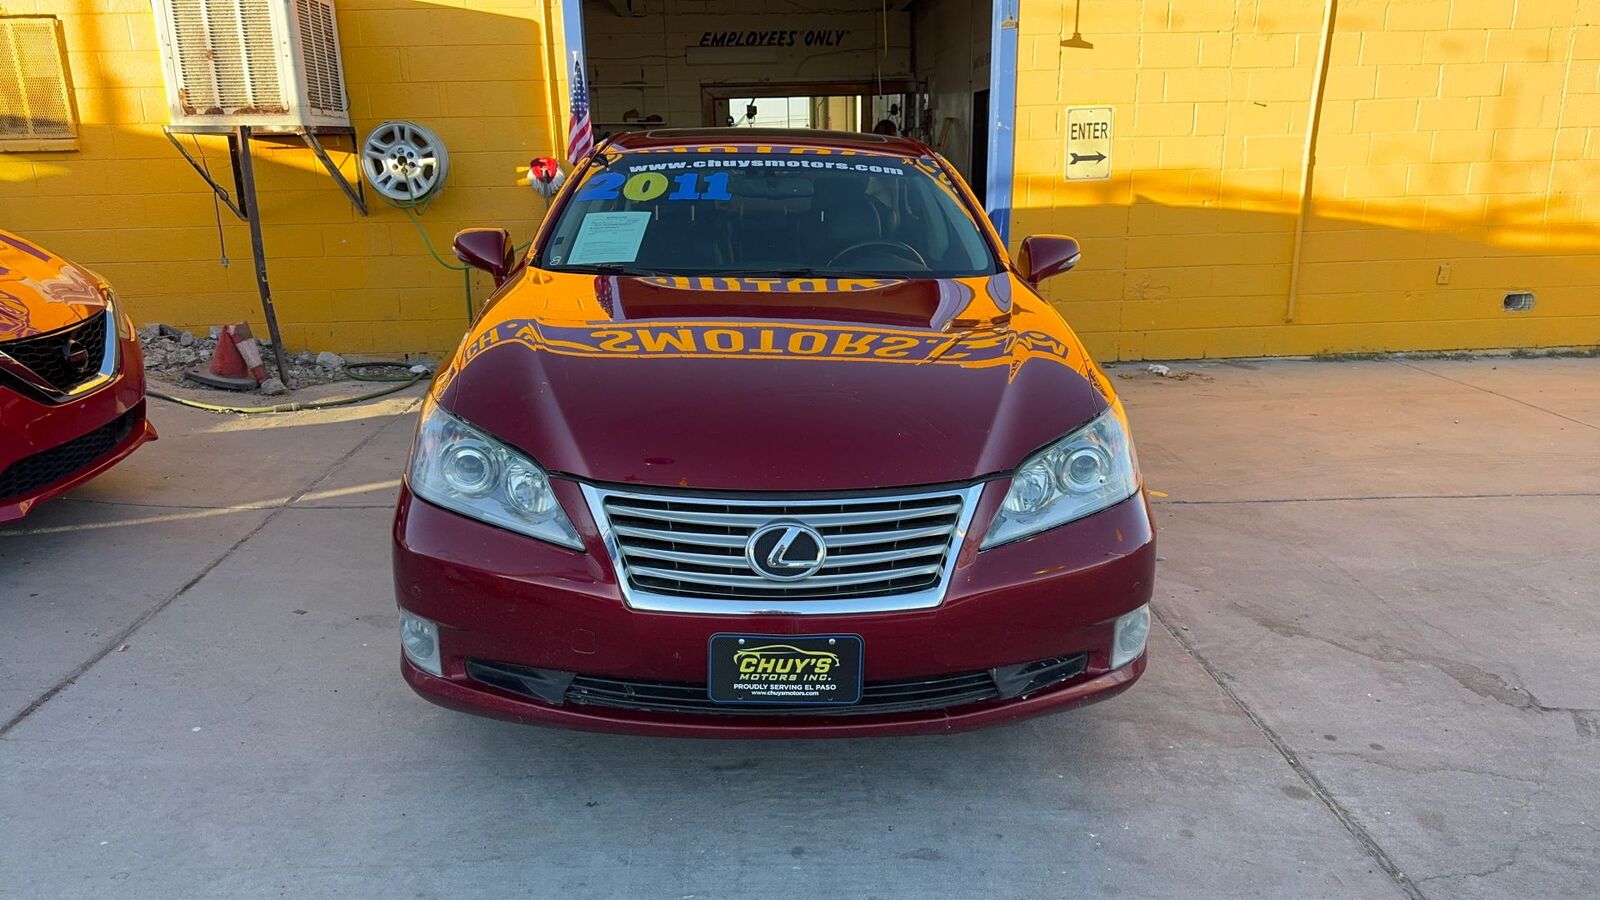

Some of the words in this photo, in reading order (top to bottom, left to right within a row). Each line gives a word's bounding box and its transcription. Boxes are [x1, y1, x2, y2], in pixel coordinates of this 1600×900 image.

[699, 31, 797, 47] EMPLOYEES
[1071, 122, 1108, 140] ENTER
[629, 159, 905, 176] www.chuysmotors.com
[578, 171, 732, 201] 2011
[739, 657, 833, 673] CHUY'S
[739, 673, 797, 681] MOTORS
